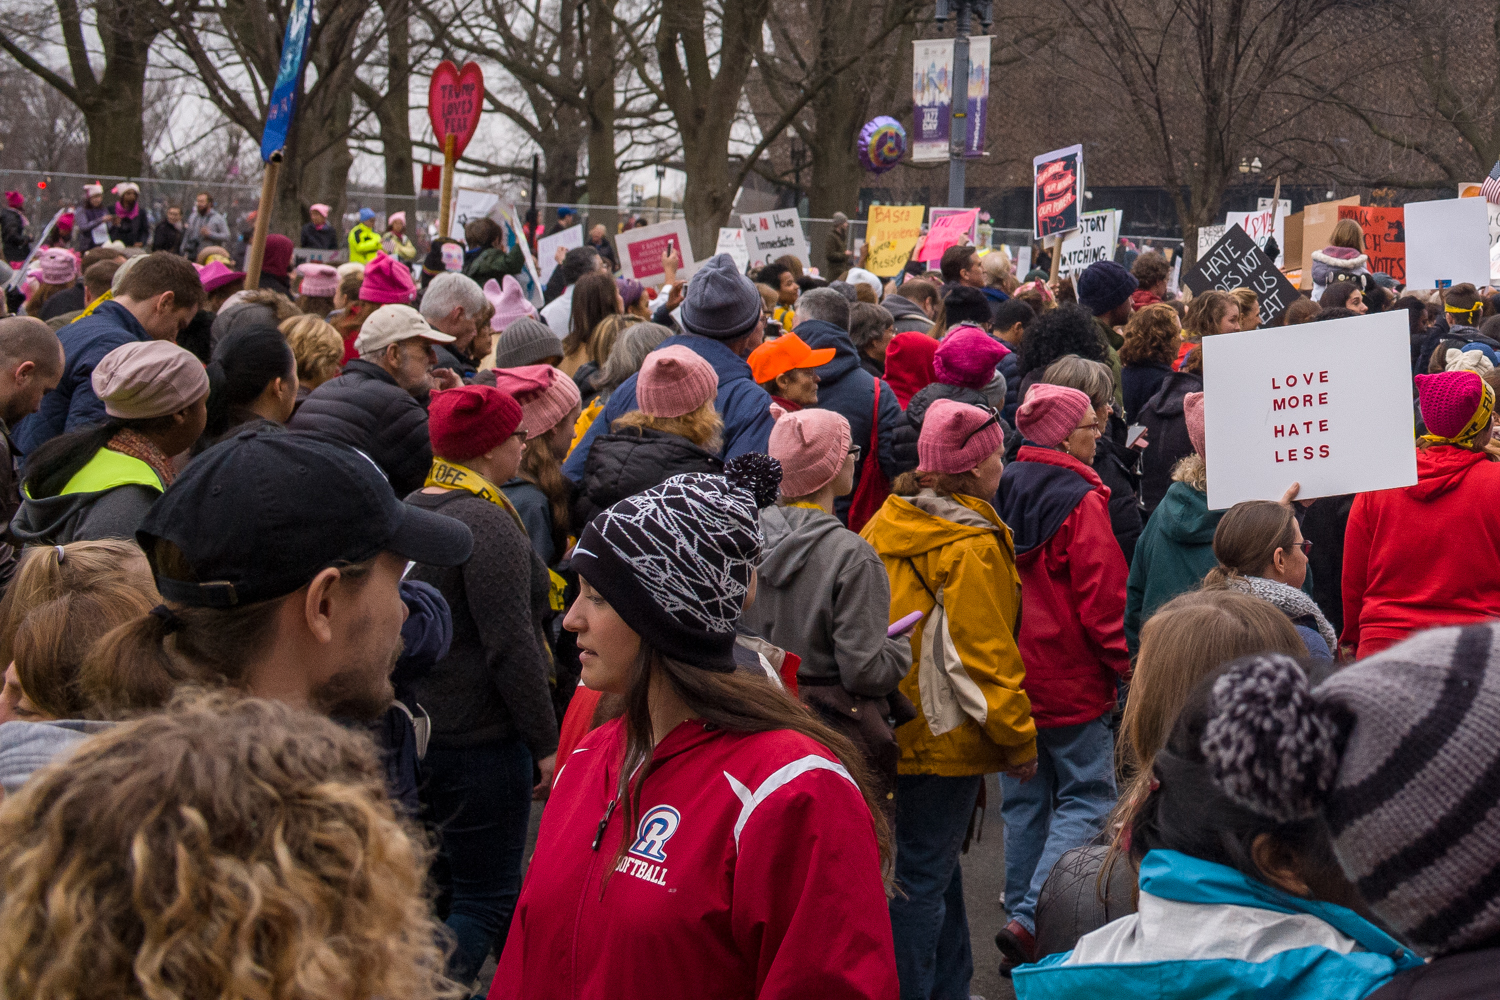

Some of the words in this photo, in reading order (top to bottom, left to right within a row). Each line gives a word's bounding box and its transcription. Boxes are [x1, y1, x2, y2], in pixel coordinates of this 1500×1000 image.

[1038, 203, 1052, 217] OUR
[1052, 192, 1072, 214] POWER
[742, 218, 757, 232] We
[772, 214, 795, 228] Have
[1080, 215, 1107, 234] STORY
[1200, 239, 1241, 282] HATE
[1214, 270, 1242, 292] OES
[1237, 245, 1262, 277] NOT
[1367, 256, 1406, 280] VOTES
[1253, 270, 1278, 294] US
[1259, 289, 1285, 325] EAT
[1272, 370, 1329, 390] LOVE
[1273, 392, 1328, 411] MORE
[1274, 419, 1329, 438] HATE
[1275, 444, 1330, 463] LESS
[435, 463, 467, 485] OFF
[629, 804, 681, 863] R
